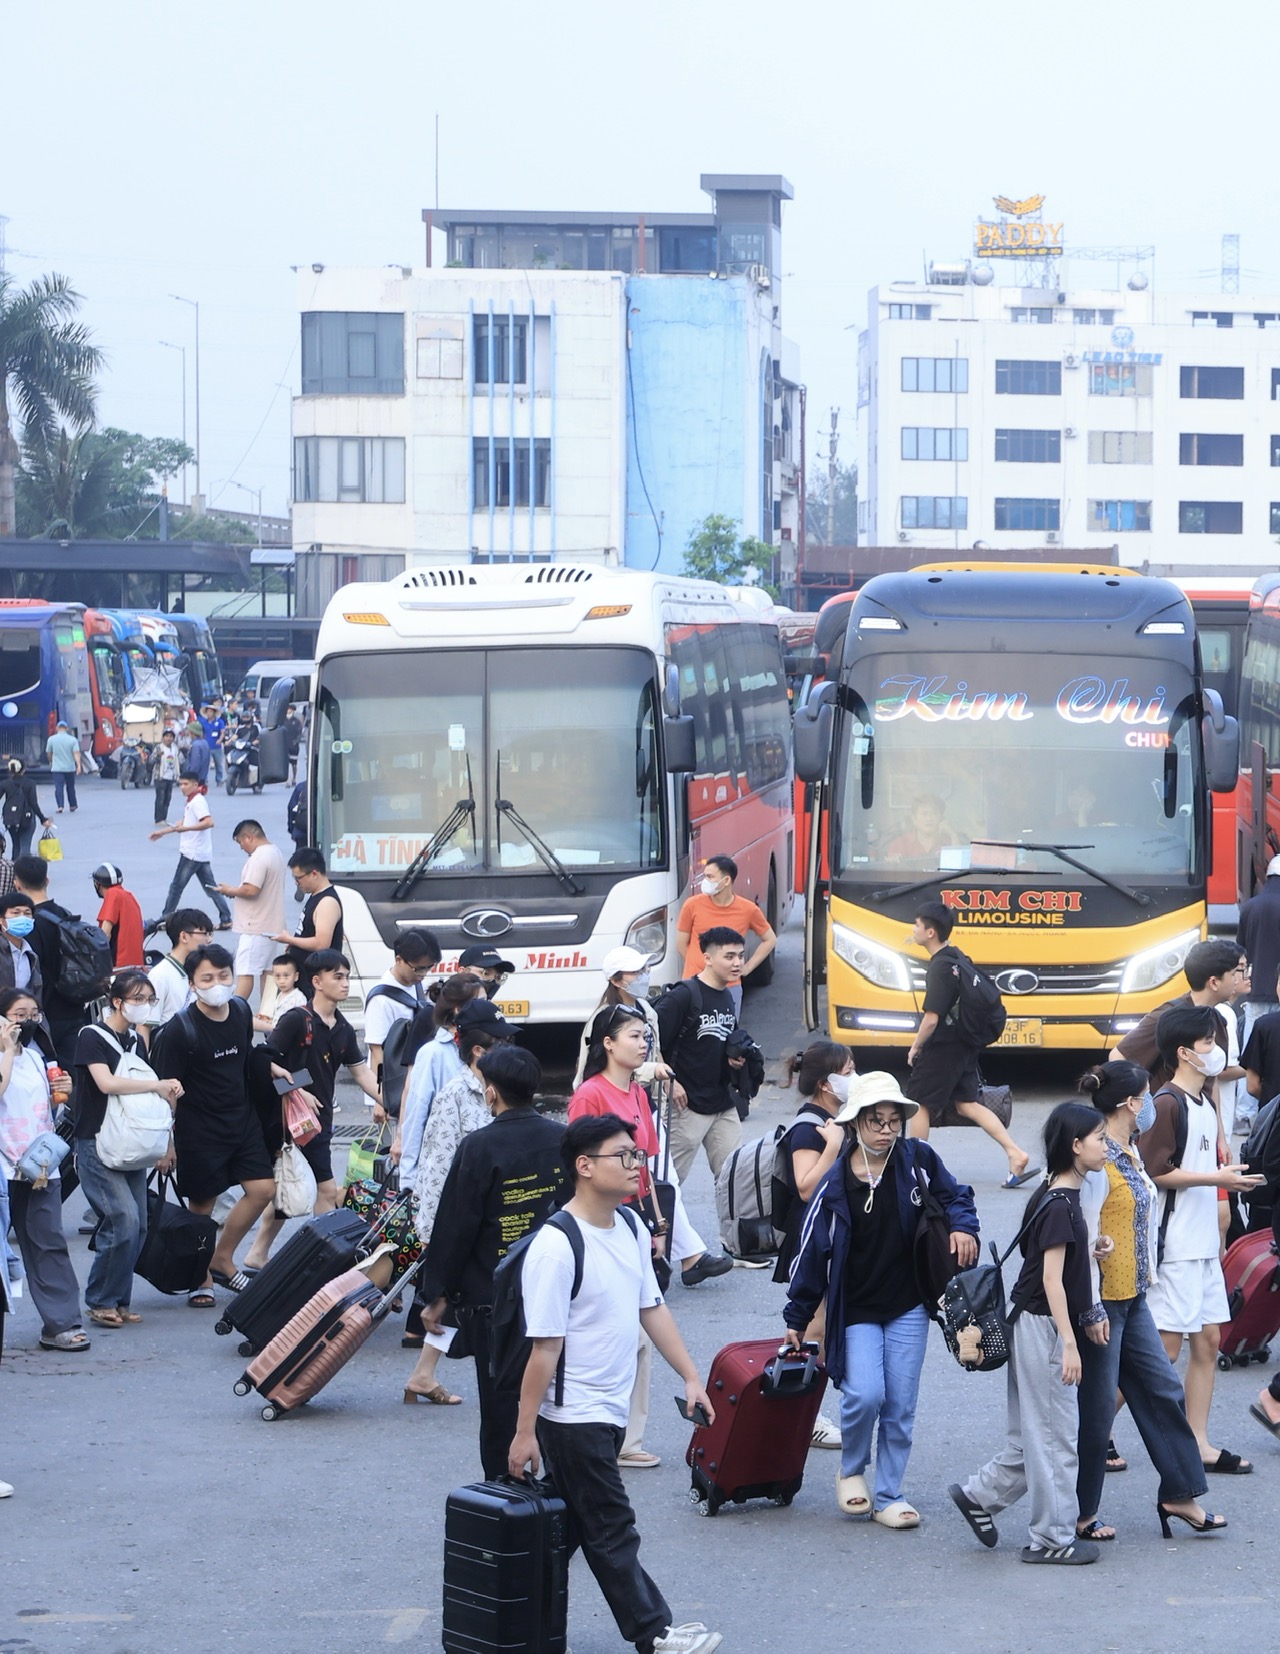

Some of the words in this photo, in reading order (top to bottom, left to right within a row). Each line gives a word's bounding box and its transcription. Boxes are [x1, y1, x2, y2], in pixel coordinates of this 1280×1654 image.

[976, 222, 1064, 247] PADDY
[875, 673, 1034, 722] Kim
[1056, 675, 1169, 725] Chi
[940, 889, 1011, 911] KIM
[1018, 890, 1082, 912] CHI
[957, 912, 1064, 925] LIMOUSINE
[524, 951, 588, 970] Minh
